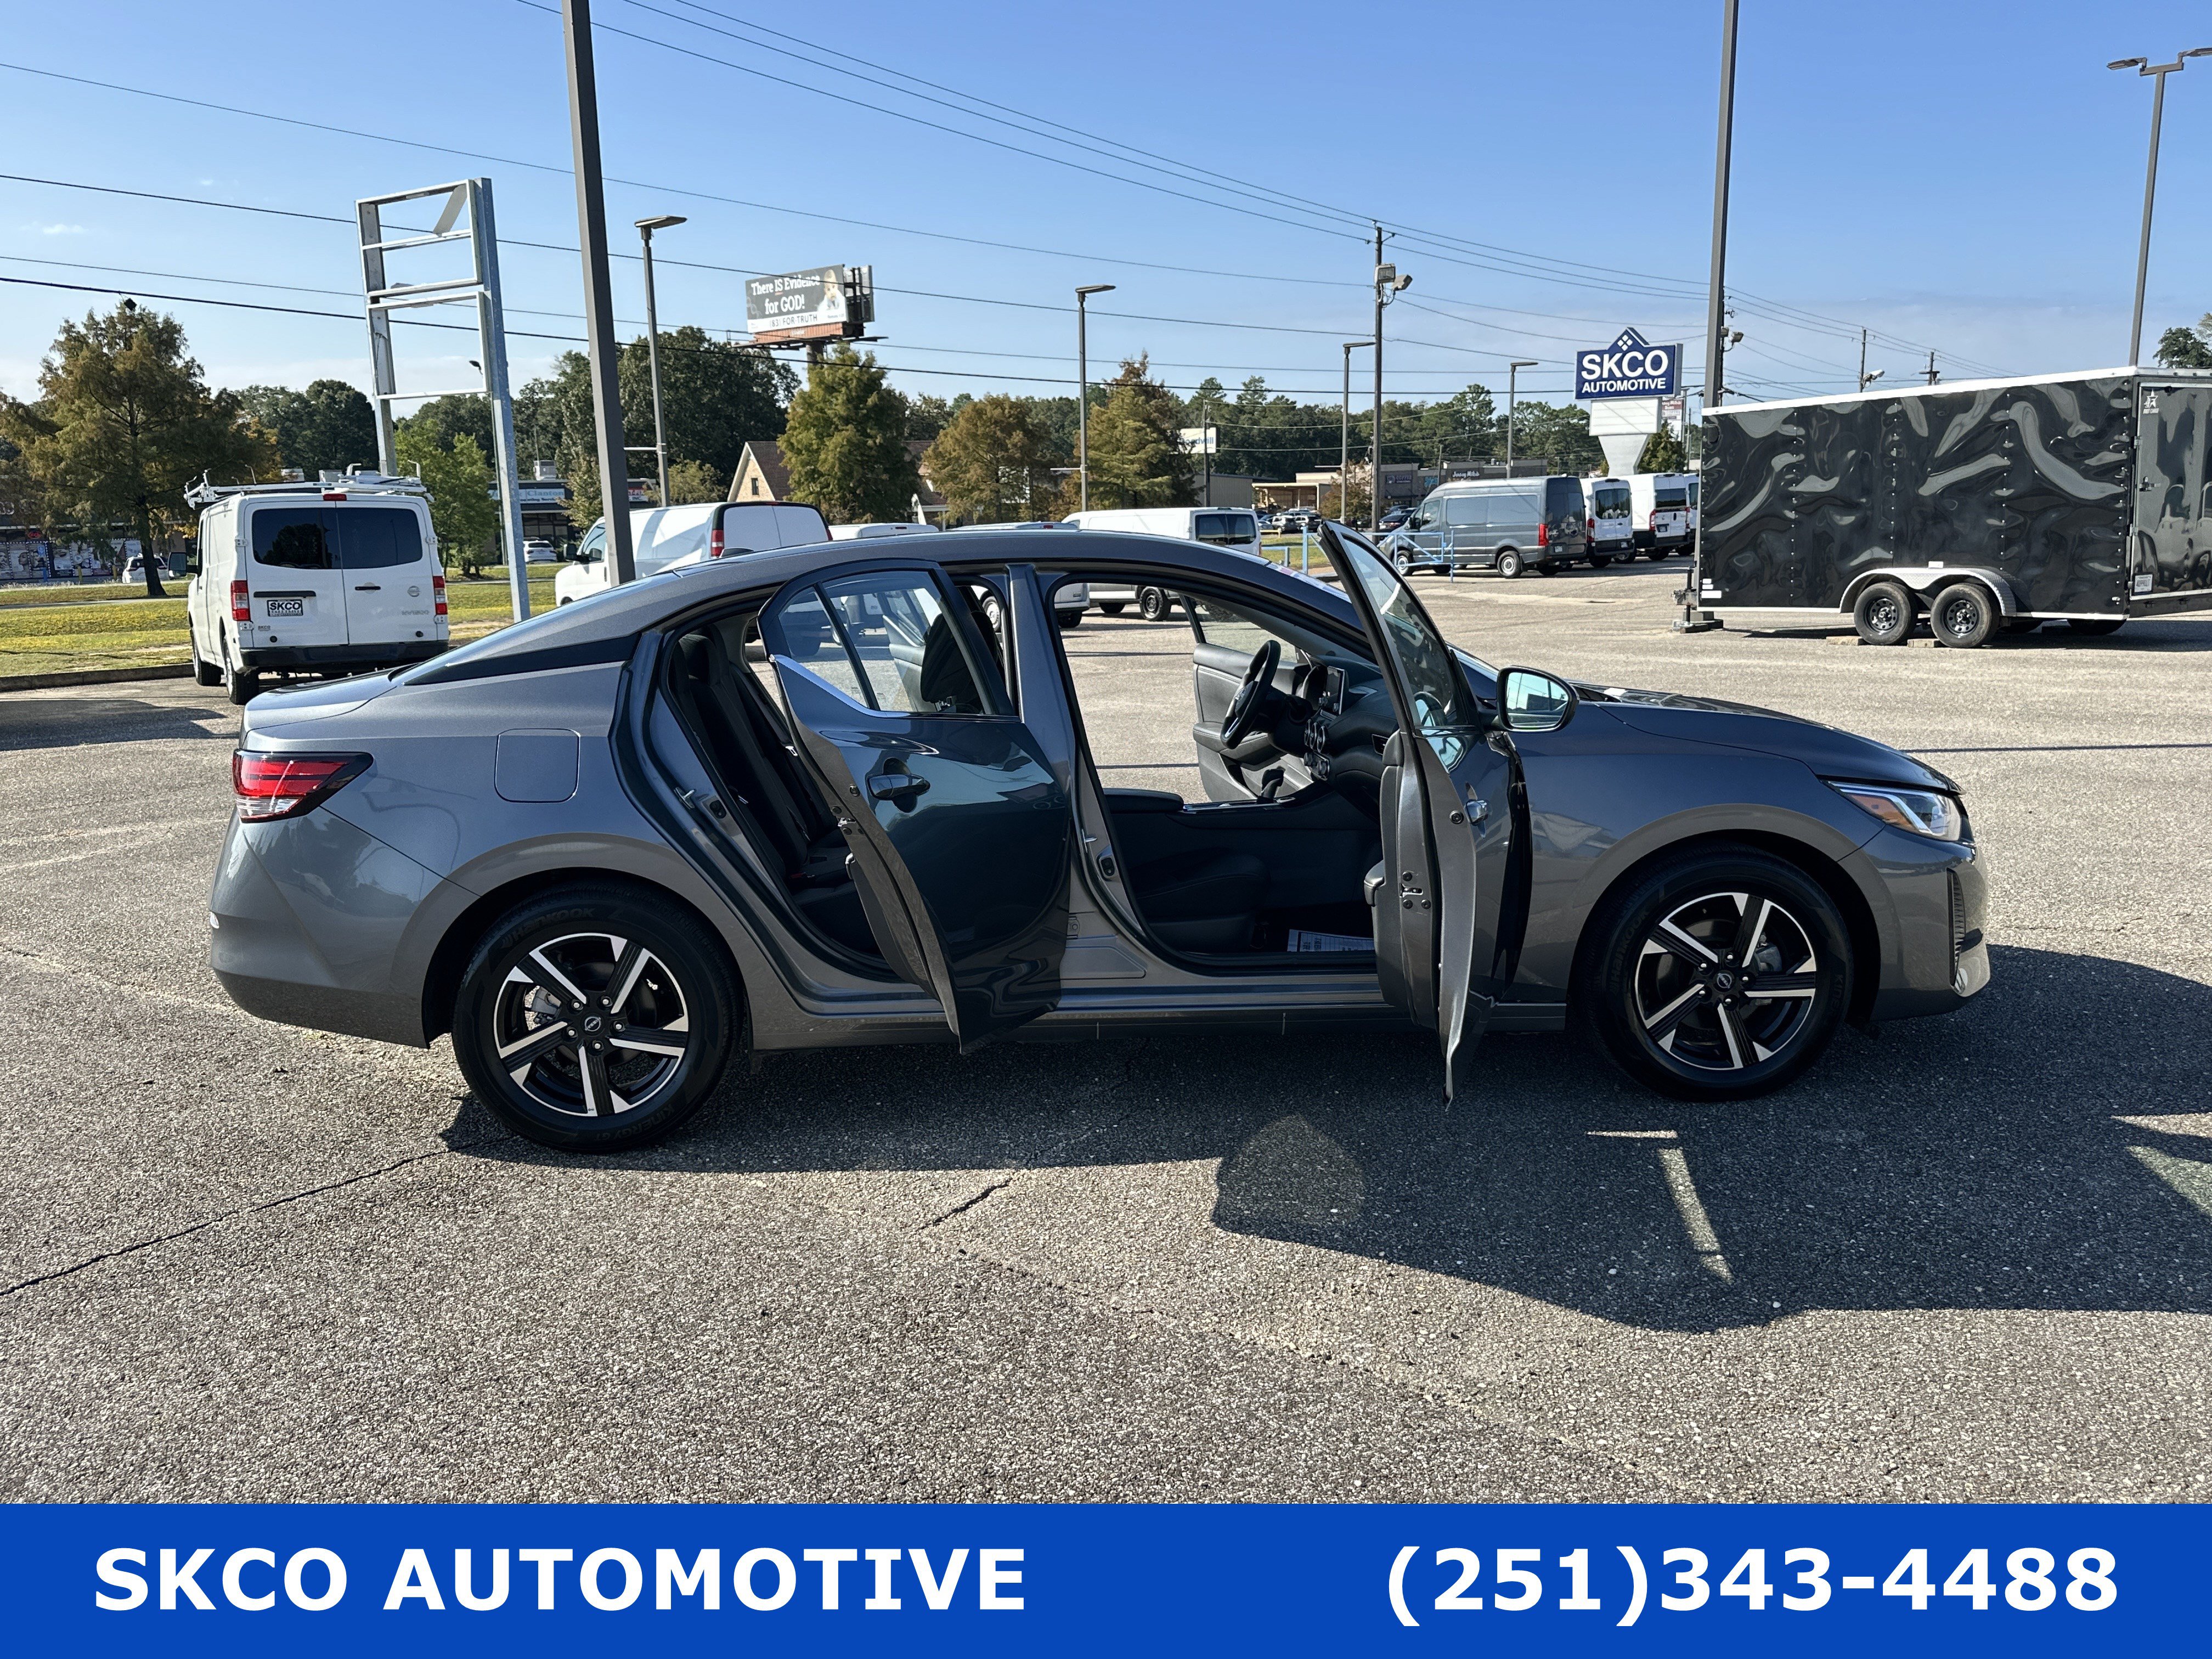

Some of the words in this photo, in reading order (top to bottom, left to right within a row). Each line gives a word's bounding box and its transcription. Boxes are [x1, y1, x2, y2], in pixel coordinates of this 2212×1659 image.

[751, 281, 774, 296] There
[774, 278, 783, 292] IS
[783, 274, 820, 290] Evidence
[764, 298, 778, 314] for
[780, 294, 805, 312] GOD!
[1581, 349, 1668, 380] SKCO
[1582, 377, 1666, 393] AUTOMOTIVE
[269, 602, 302, 610] SKCO
